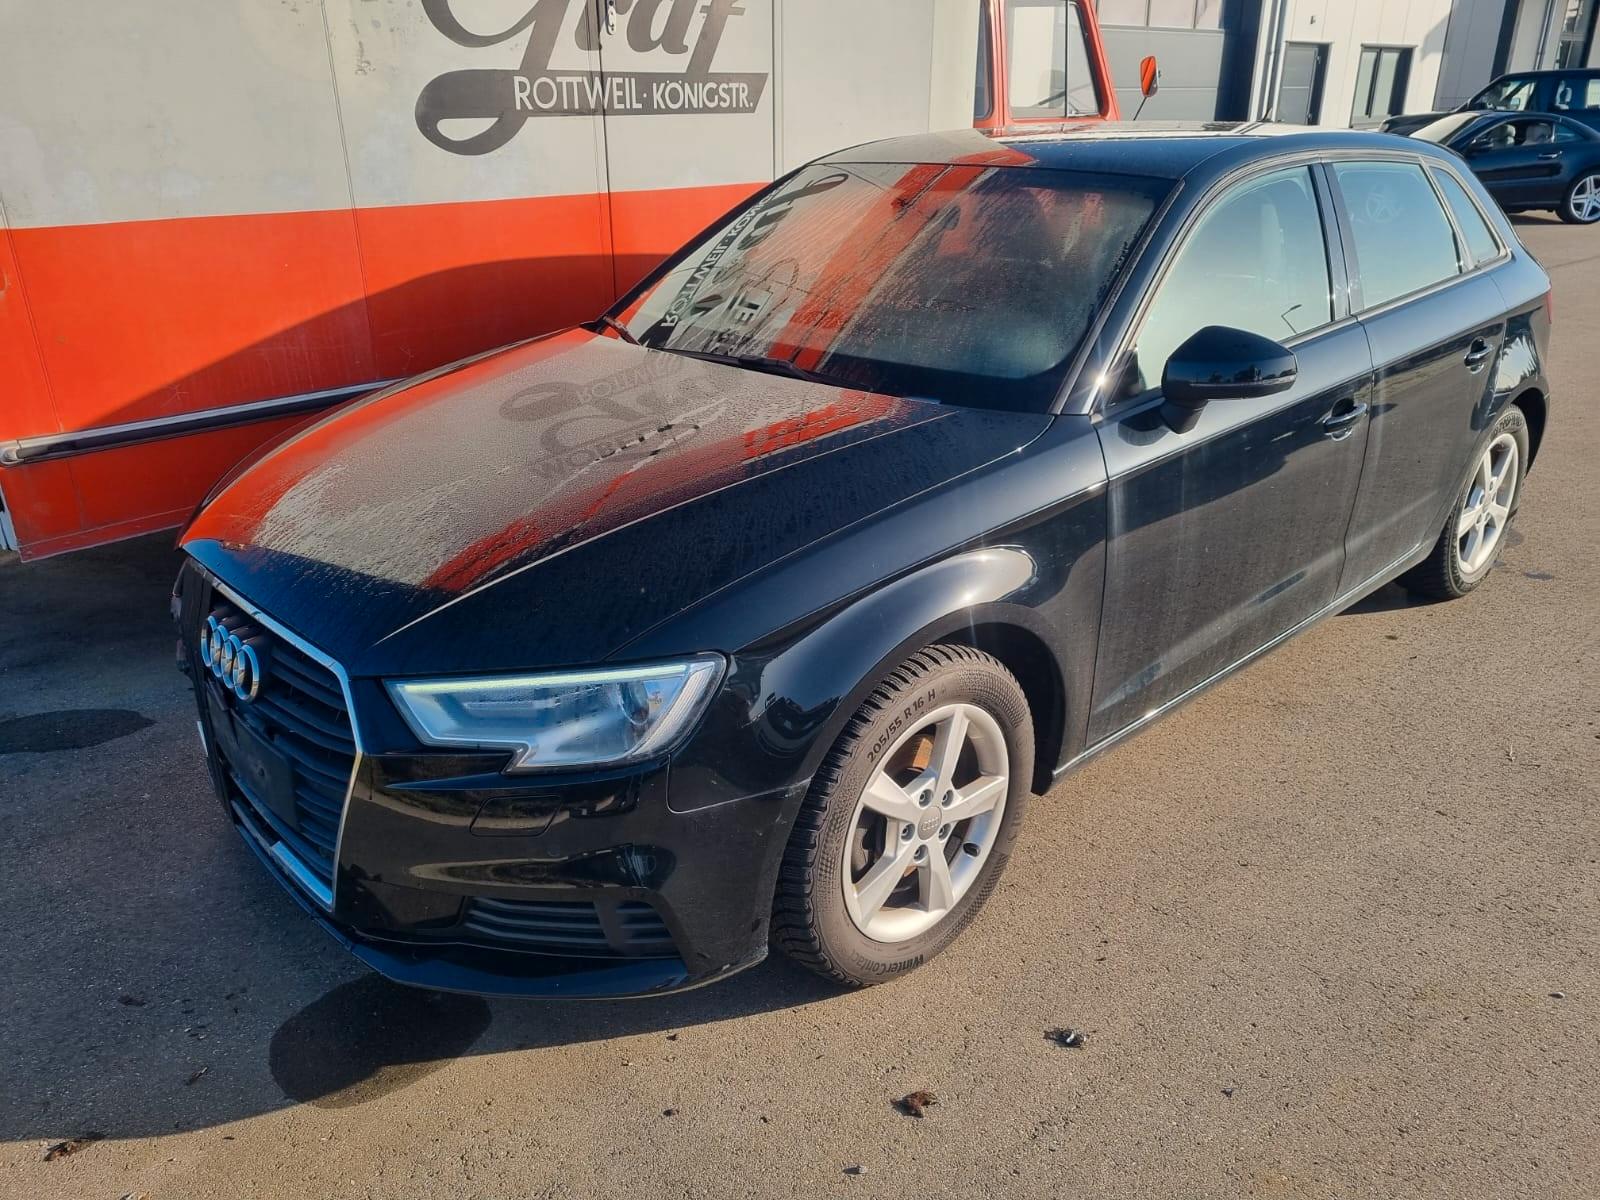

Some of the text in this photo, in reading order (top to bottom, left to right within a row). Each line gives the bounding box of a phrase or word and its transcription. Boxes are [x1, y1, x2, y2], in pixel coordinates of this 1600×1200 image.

[513, 75, 754, 111] ROTTWEIL KÖNIGSTR.
[867, 716, 902, 763] 205/55
